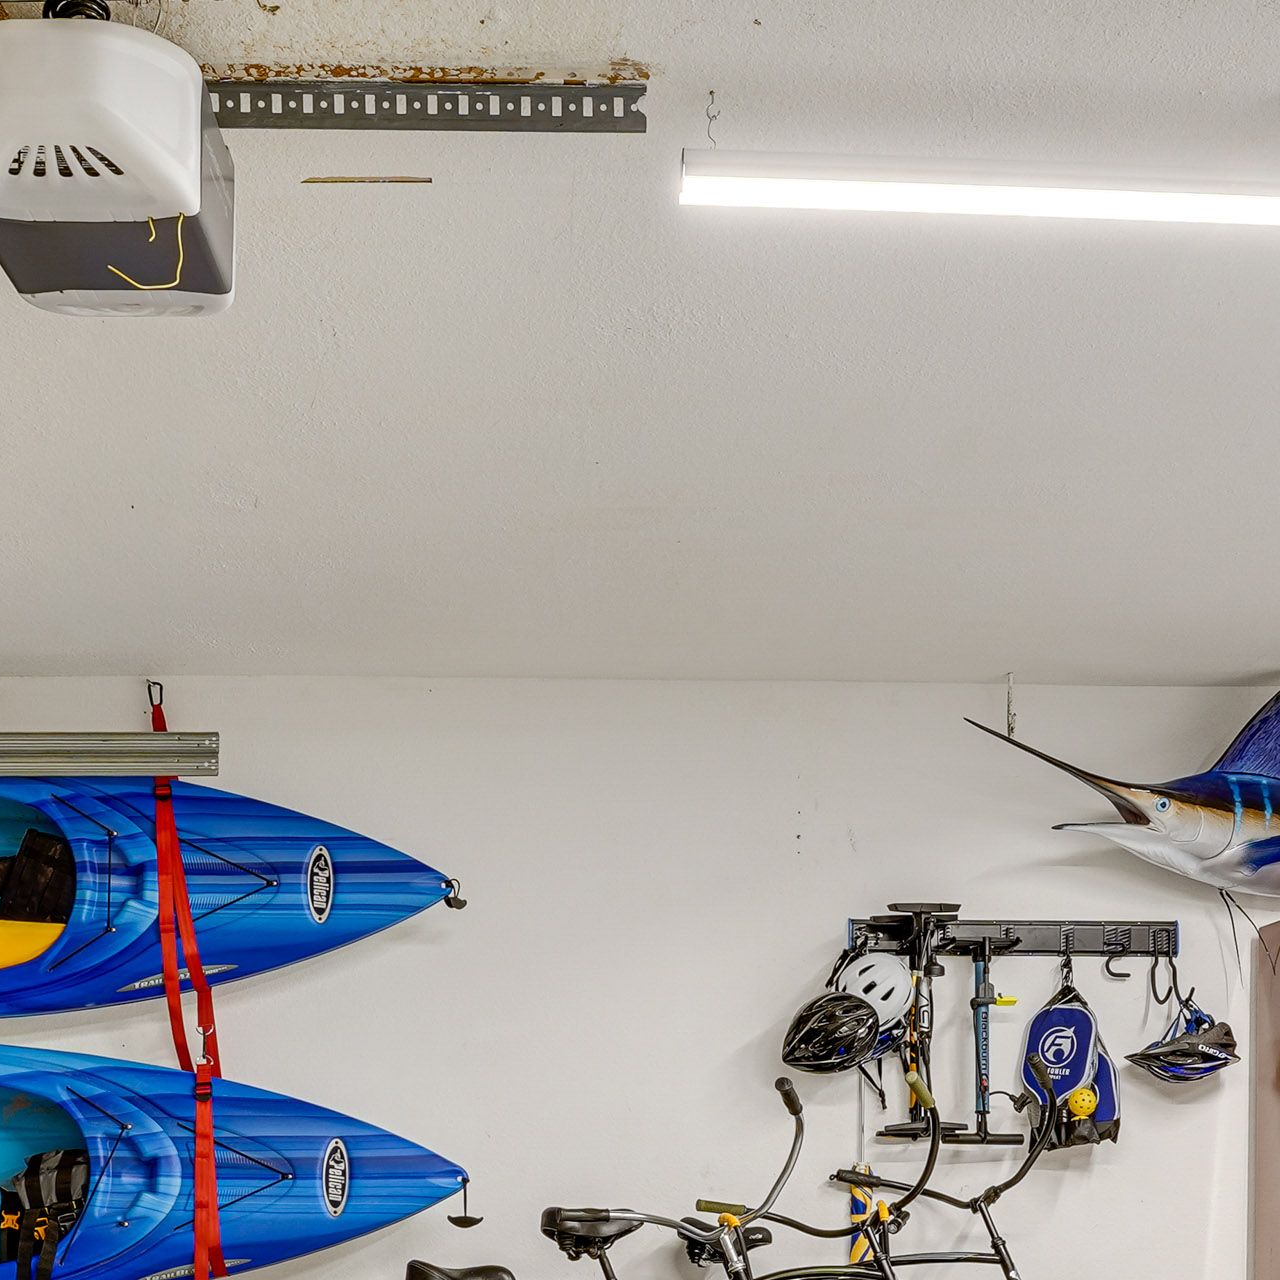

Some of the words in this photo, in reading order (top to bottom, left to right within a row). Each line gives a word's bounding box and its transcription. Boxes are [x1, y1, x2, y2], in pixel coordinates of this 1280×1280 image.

[313, 866, 329, 909] Pelican
[981, 1011, 989, 1070] Blackburn
[1199, 1044, 1220, 1057] GIRO
[328, 1159, 345, 1201] Pelican
